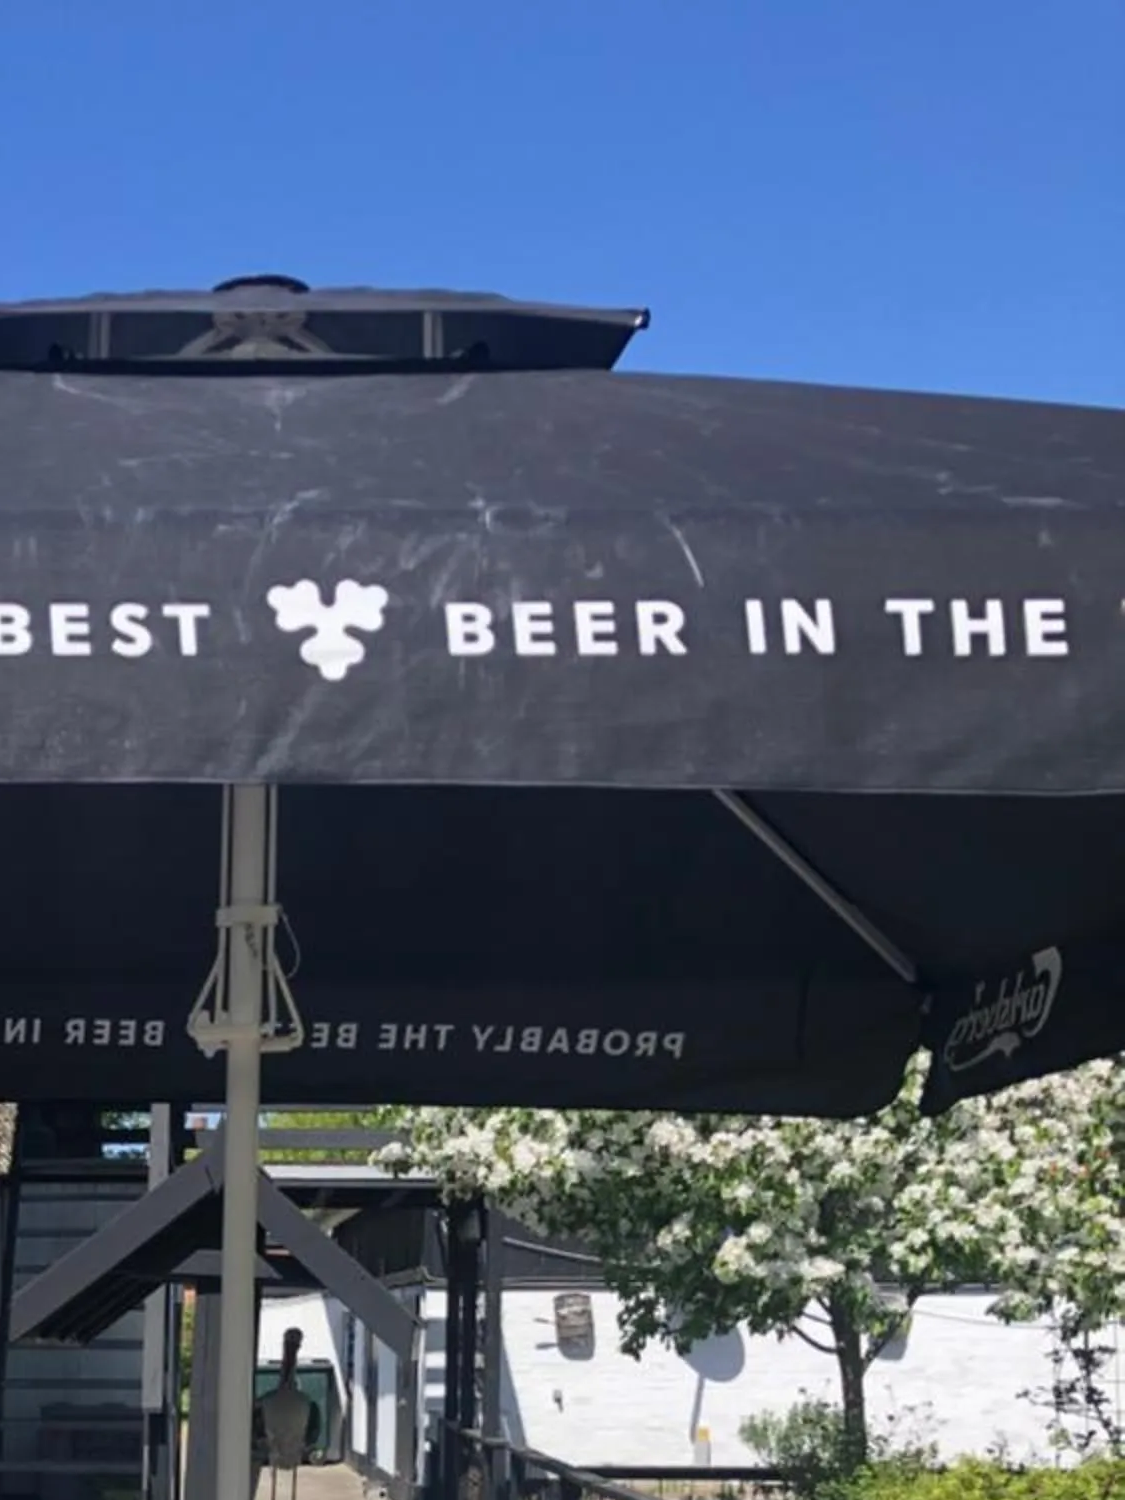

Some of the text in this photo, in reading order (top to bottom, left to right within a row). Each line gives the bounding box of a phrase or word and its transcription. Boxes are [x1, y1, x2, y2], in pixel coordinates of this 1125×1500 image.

[445, 600, 687, 656] BEER
[745, 599, 835, 654] IN
[885, 599, 1069, 656] THE
